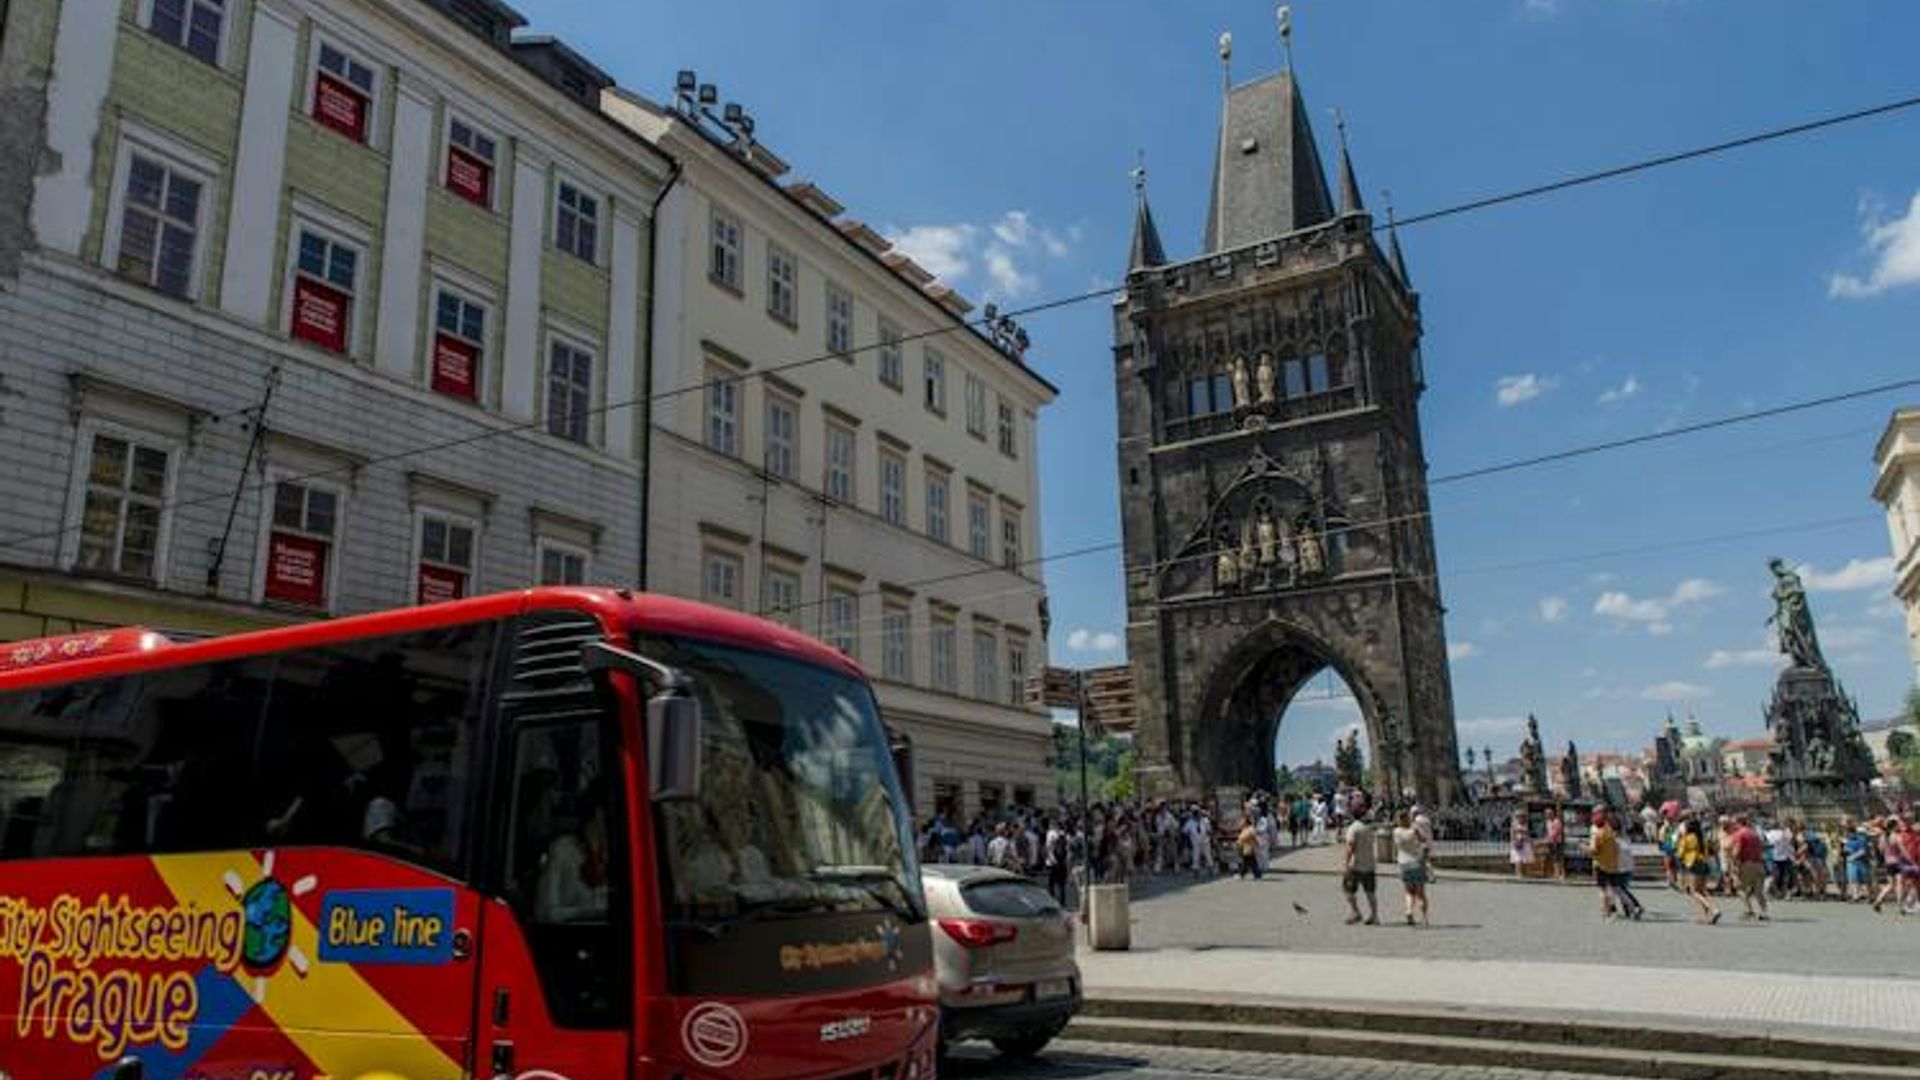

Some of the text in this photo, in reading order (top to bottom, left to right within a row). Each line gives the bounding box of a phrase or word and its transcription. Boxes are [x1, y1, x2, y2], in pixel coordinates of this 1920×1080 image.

[49, 893, 244, 973] Sightseeing
[328, 906, 442, 947] Blue line
[18, 951, 197, 1060] Prague
